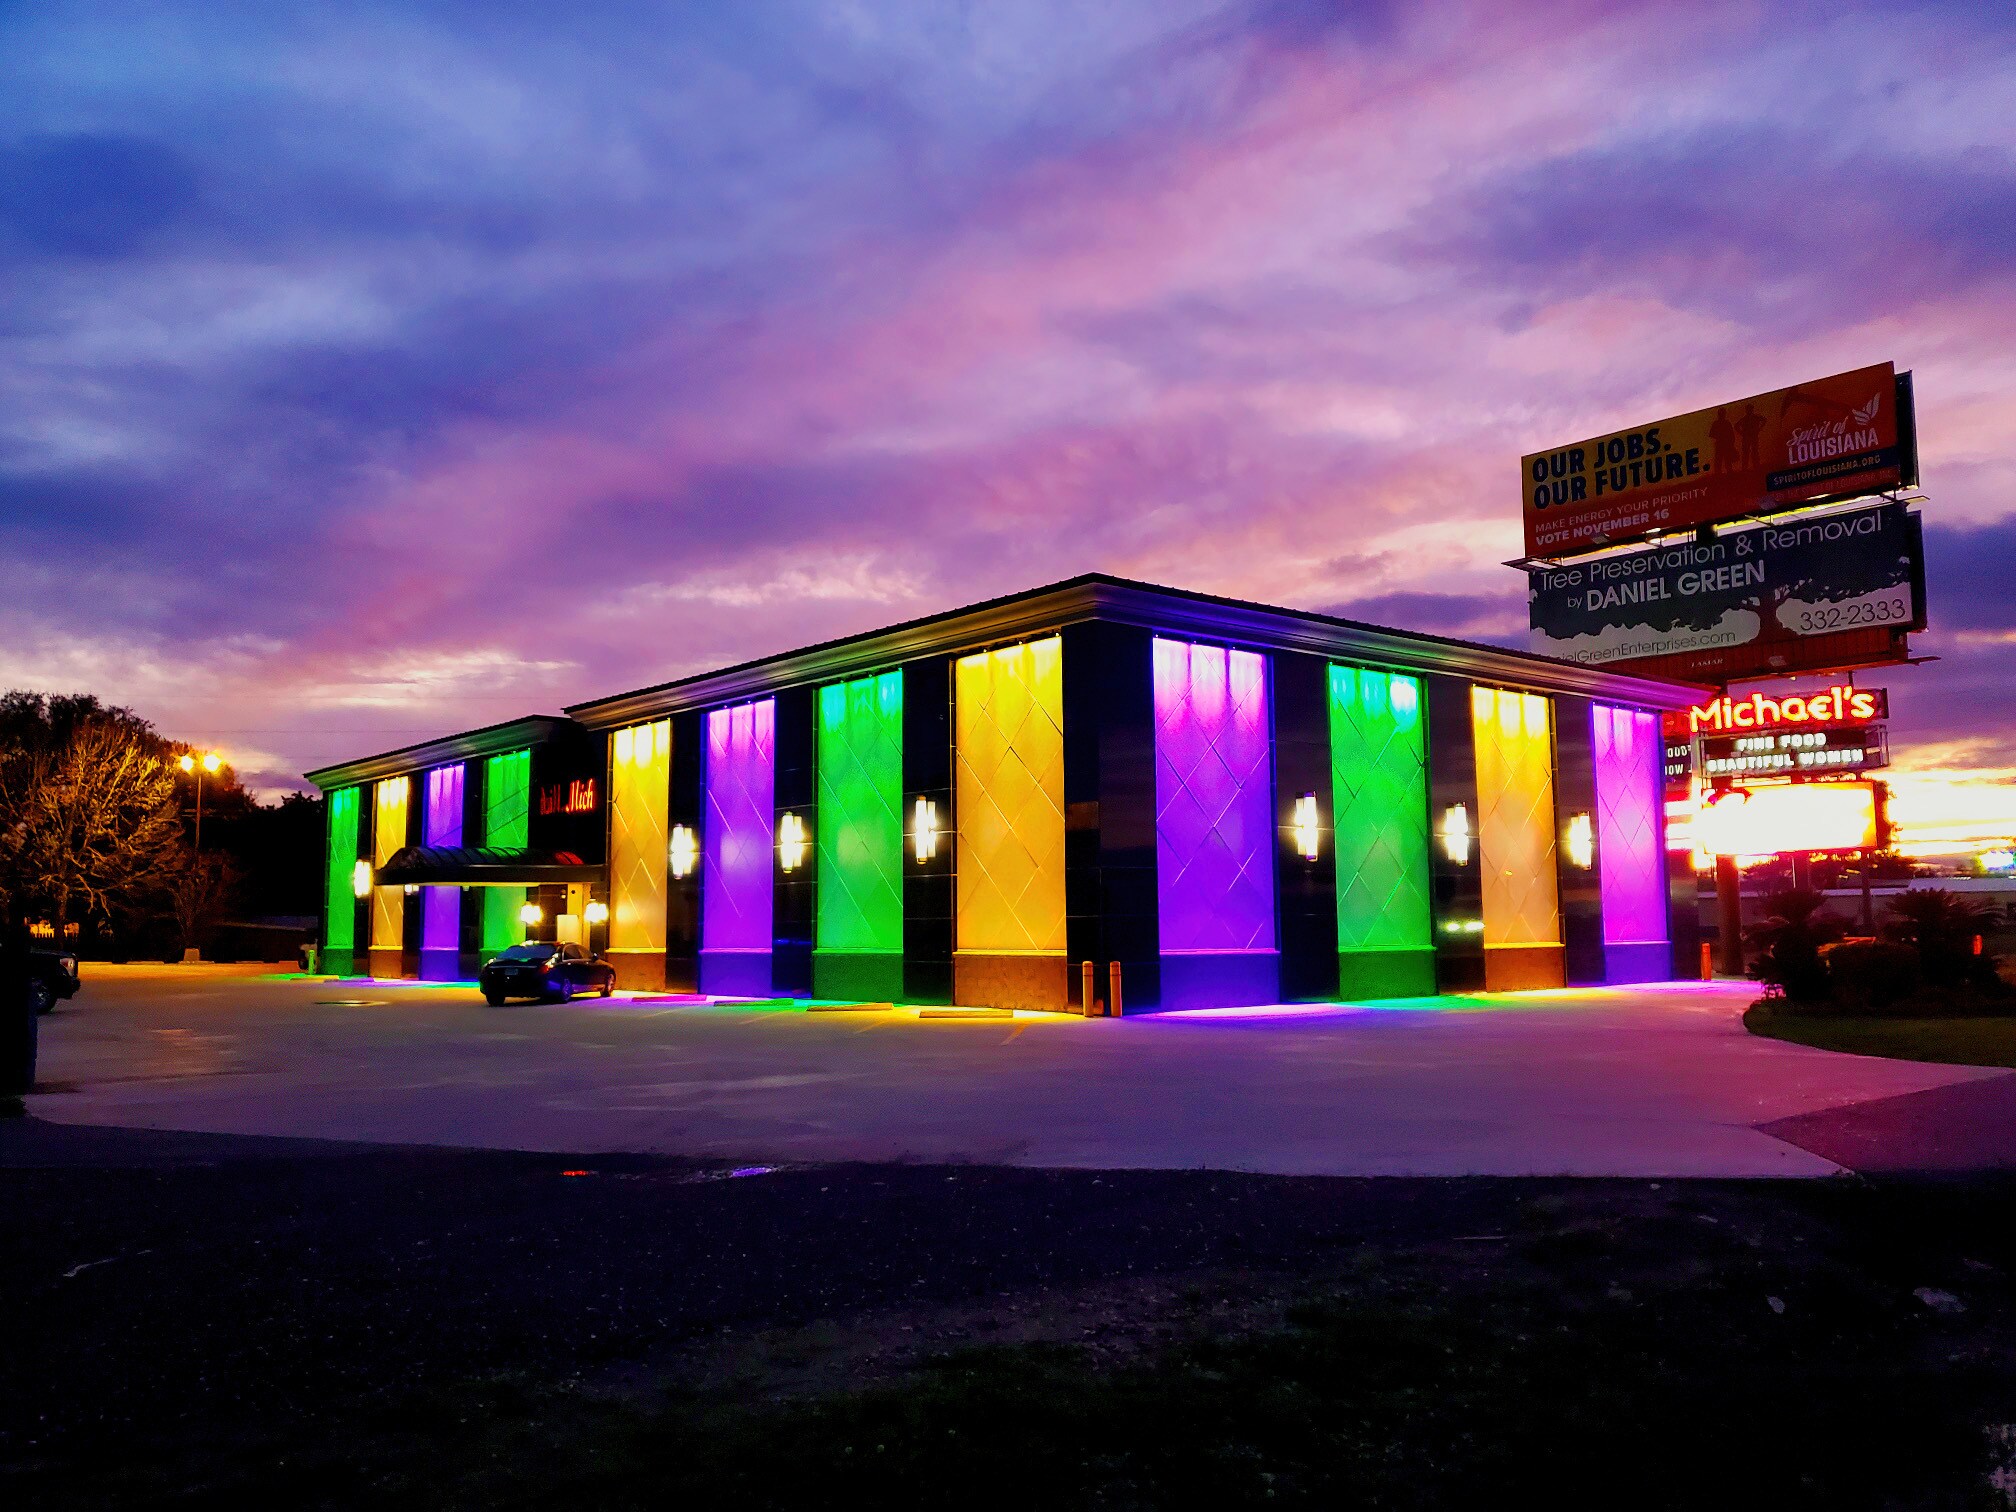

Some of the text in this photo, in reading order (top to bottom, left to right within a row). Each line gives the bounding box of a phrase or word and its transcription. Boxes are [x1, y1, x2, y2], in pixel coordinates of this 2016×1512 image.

[1786, 415, 1849, 446] Spirit of
[1788, 427, 1879, 464] LOUISIANA
[1533, 428, 1672, 482] OUR JOBS.
[1774, 454, 1881, 485] SPIRITOFLOUISIANA.ORG
[1534, 448, 1711, 509] OUR FUTURE.
[1535, 487, 1708, 533] MAKE ENERGY YOUR PRIORITY
[1536, 509, 1670, 546] VOTE NOVEMBER 16
[1541, 510, 1882, 591] Tree Preservation & Removal
[1567, 559, 1765, 611] by DANIEL GREEN
[1800, 598, 1906, 631] 332-2333
[1557, 631, 1736, 663] ielGreenEnterprises.com
[1690, 657, 1725, 669] LAMAR
[1690, 685, 1875, 733] Michael's
[1779, 732, 1827, 749] FOOD
[1705, 753, 1795, 773] BEAUTIFUL
[1798, 748, 1864, 766] WOMEN
